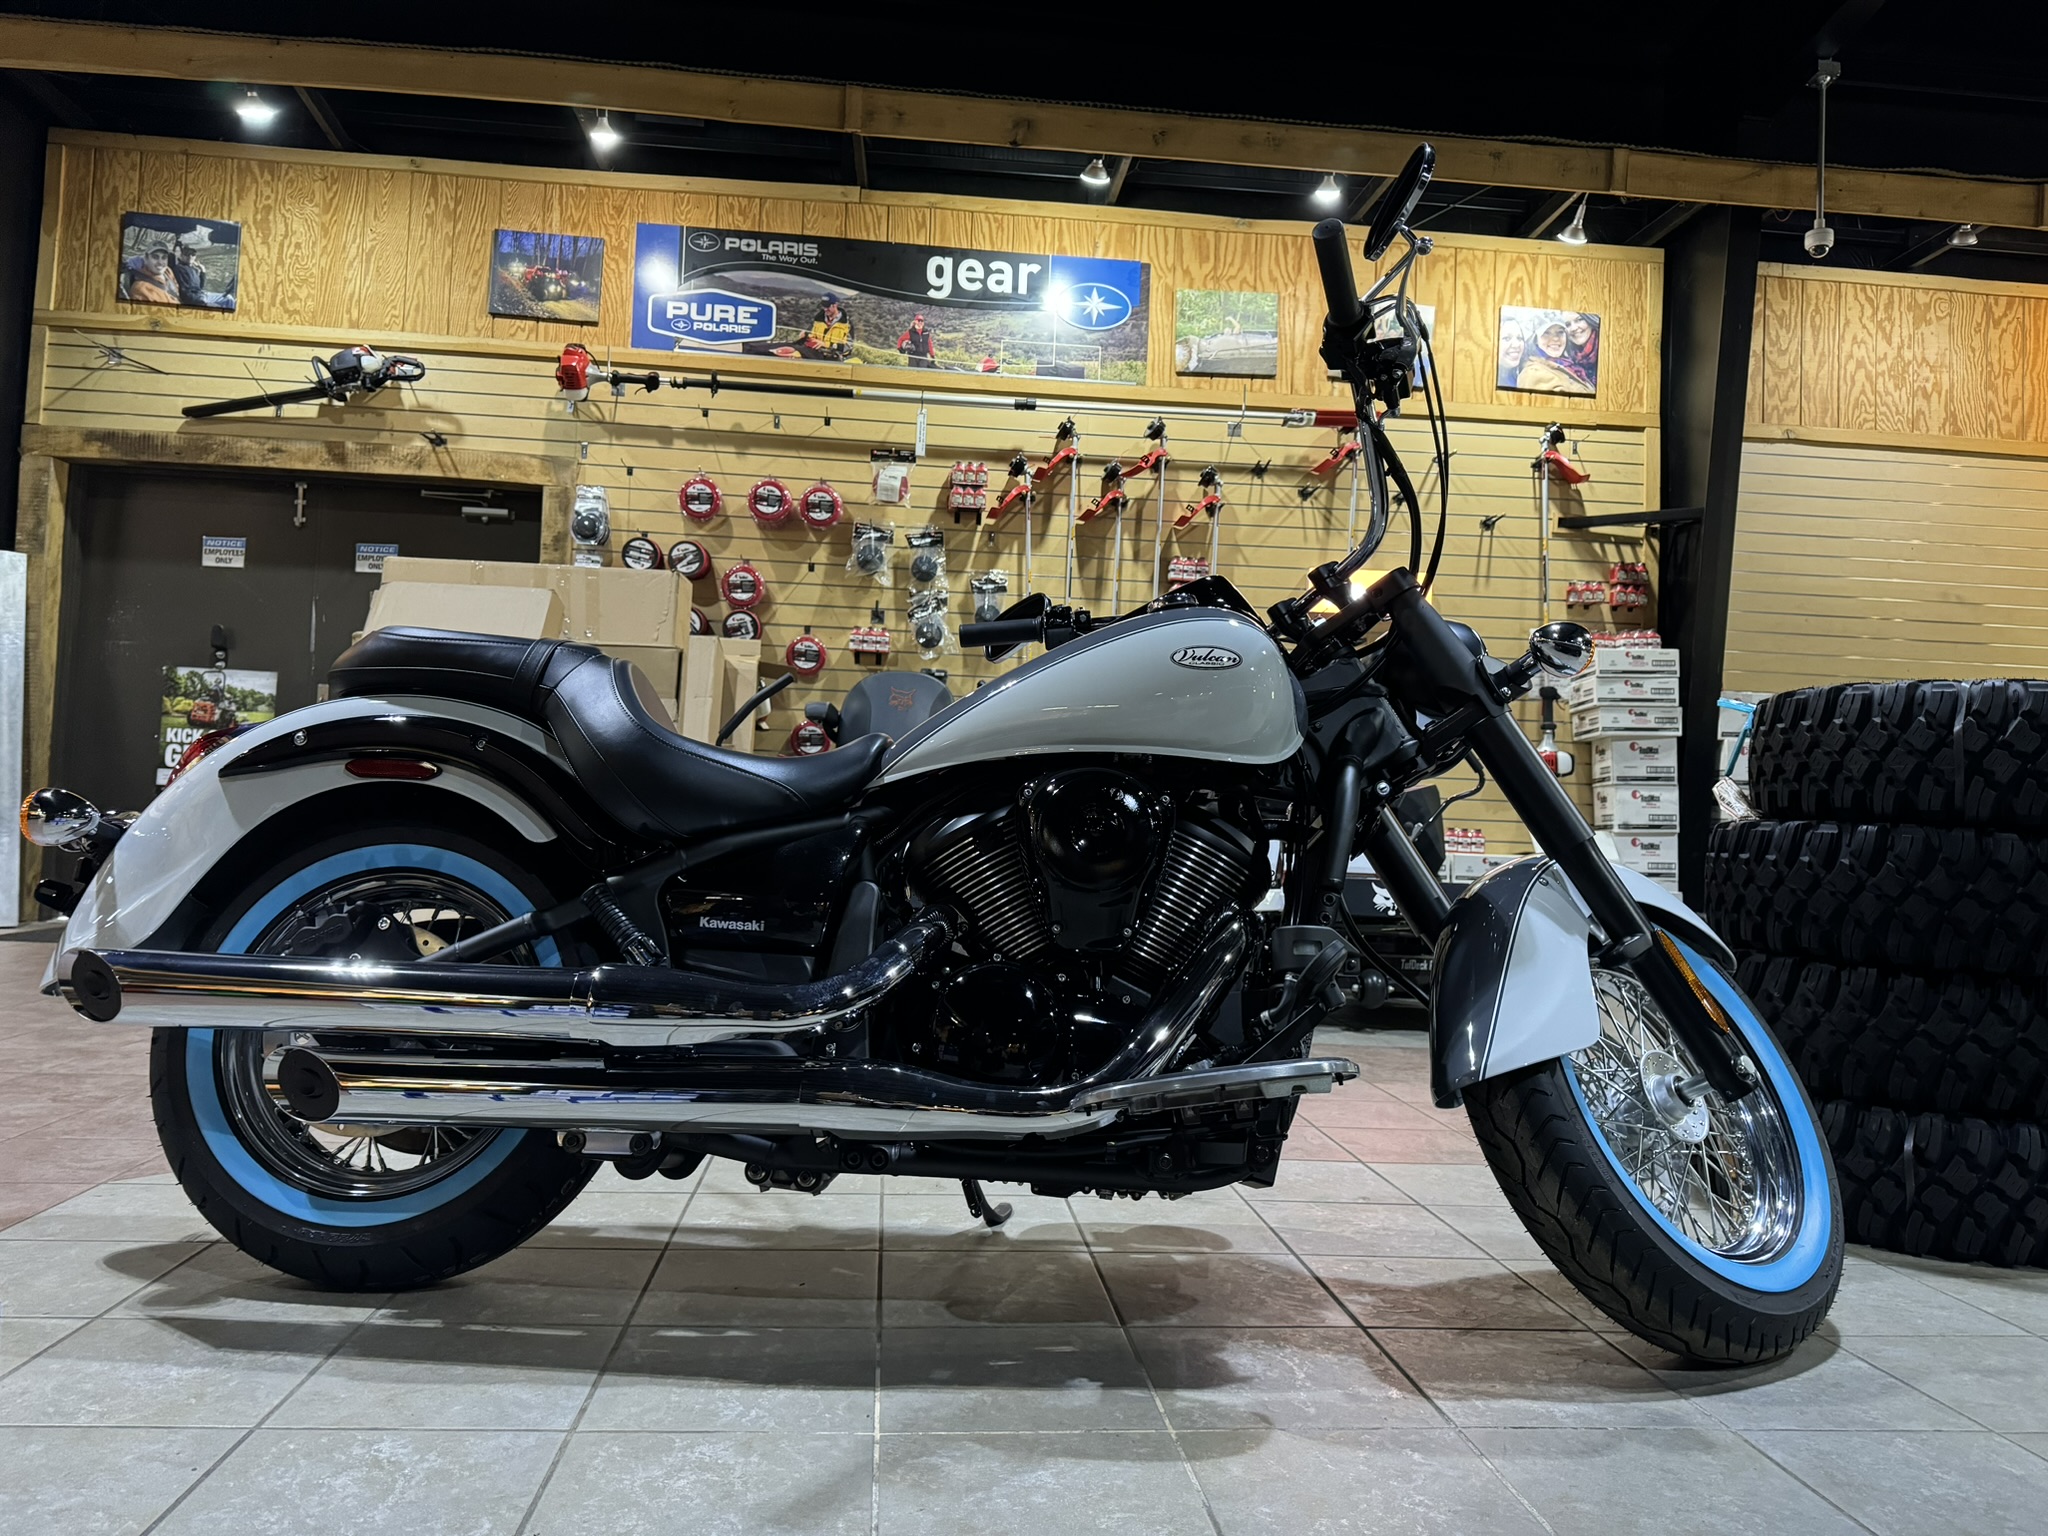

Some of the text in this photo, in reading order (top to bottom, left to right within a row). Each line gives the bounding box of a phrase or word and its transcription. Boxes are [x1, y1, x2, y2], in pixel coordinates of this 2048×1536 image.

[725, 237, 819, 257] POLARIS
[762, 253, 818, 265] The Way Out.
[926, 254, 1042, 299] gear
[666, 301, 758, 325] PURE
[693, 322, 752, 334] POLARIS
[206, 539, 243, 547] NOTICE
[359, 545, 396, 553] NOTICE
[203, 548, 245, 557] EMPLOYEES
[214, 556, 233, 564] ONLY
[1177, 648, 1239, 663] Vulcan
[166, 727, 204, 744] KICK
[699, 916, 765, 931] Kawasaki
